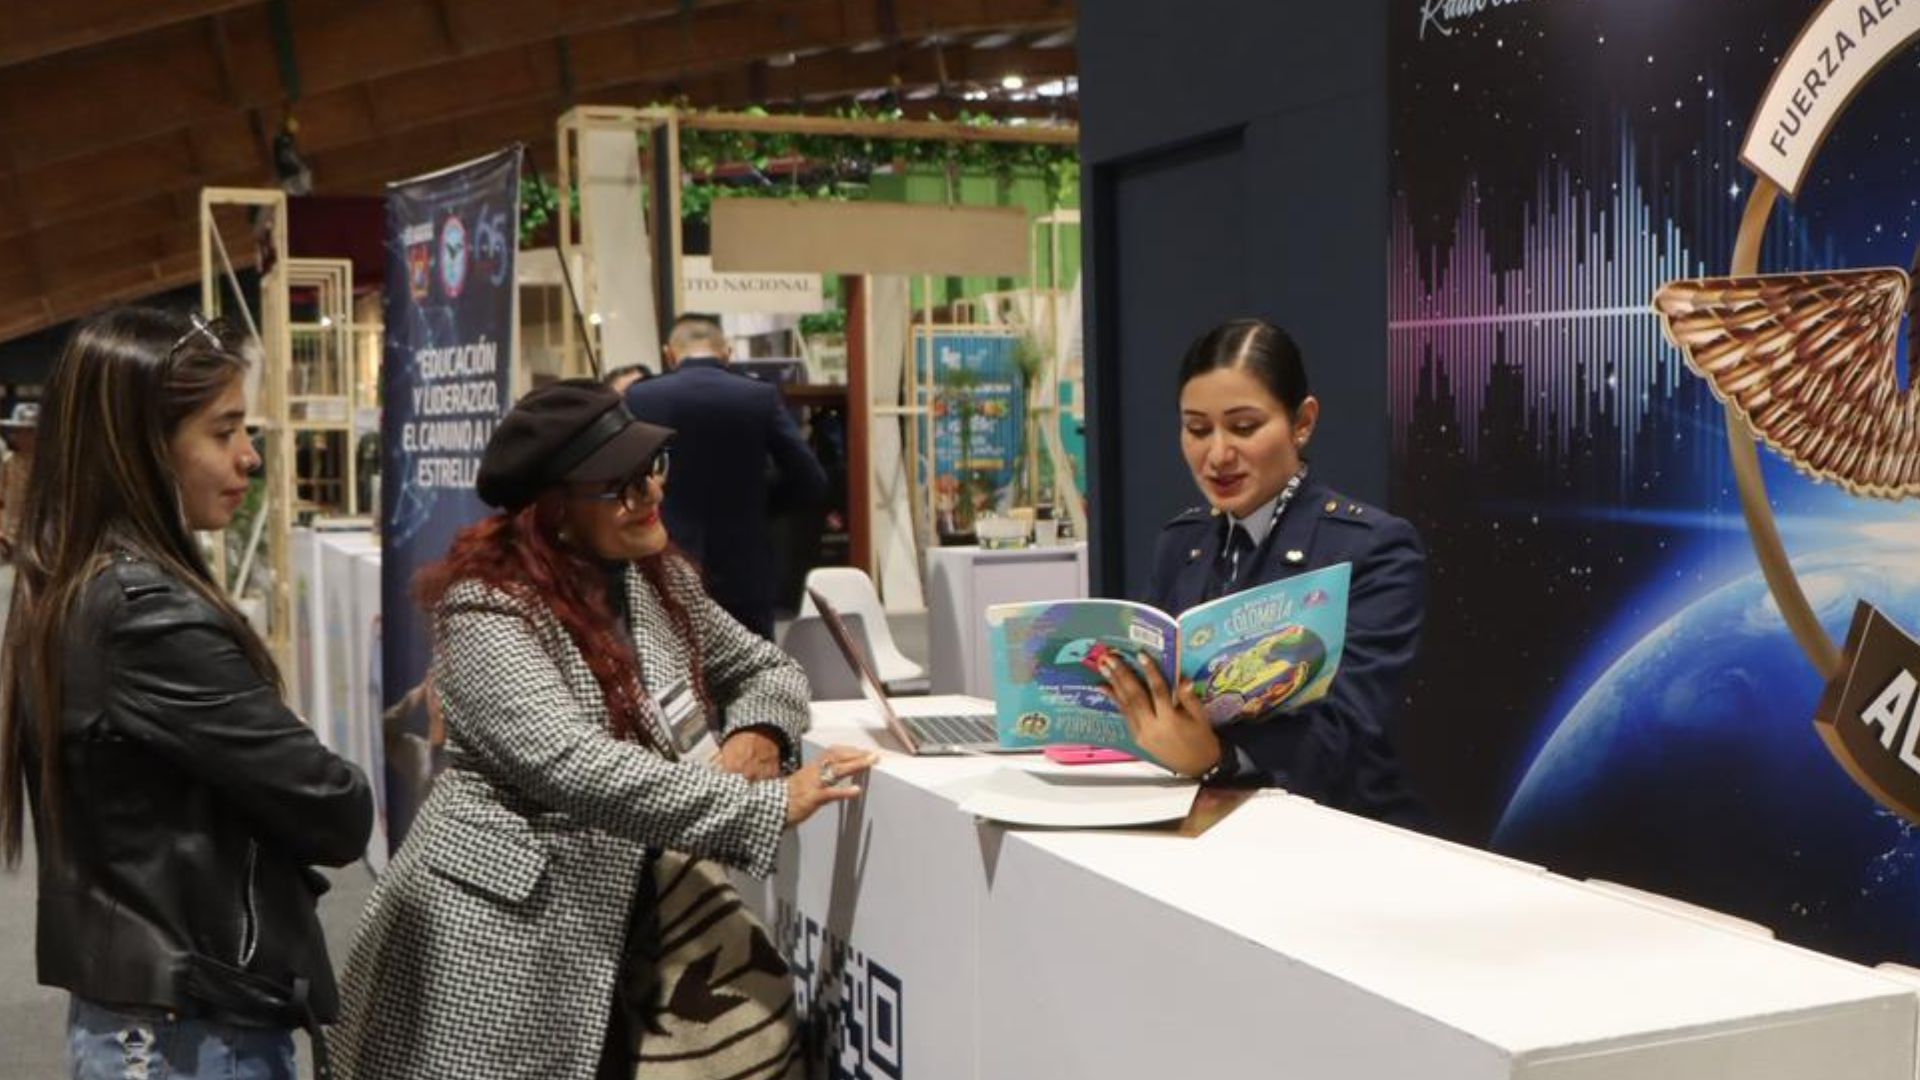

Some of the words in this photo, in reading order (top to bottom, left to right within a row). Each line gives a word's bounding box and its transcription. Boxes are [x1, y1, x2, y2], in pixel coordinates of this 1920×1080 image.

[1770, 31, 1856, 157] FUERZA
[723, 278, 812, 292] NACIONAL
[412, 387, 423, 416] Y
[403, 422, 419, 452] EL
[420, 420, 472, 451] CAMINO
